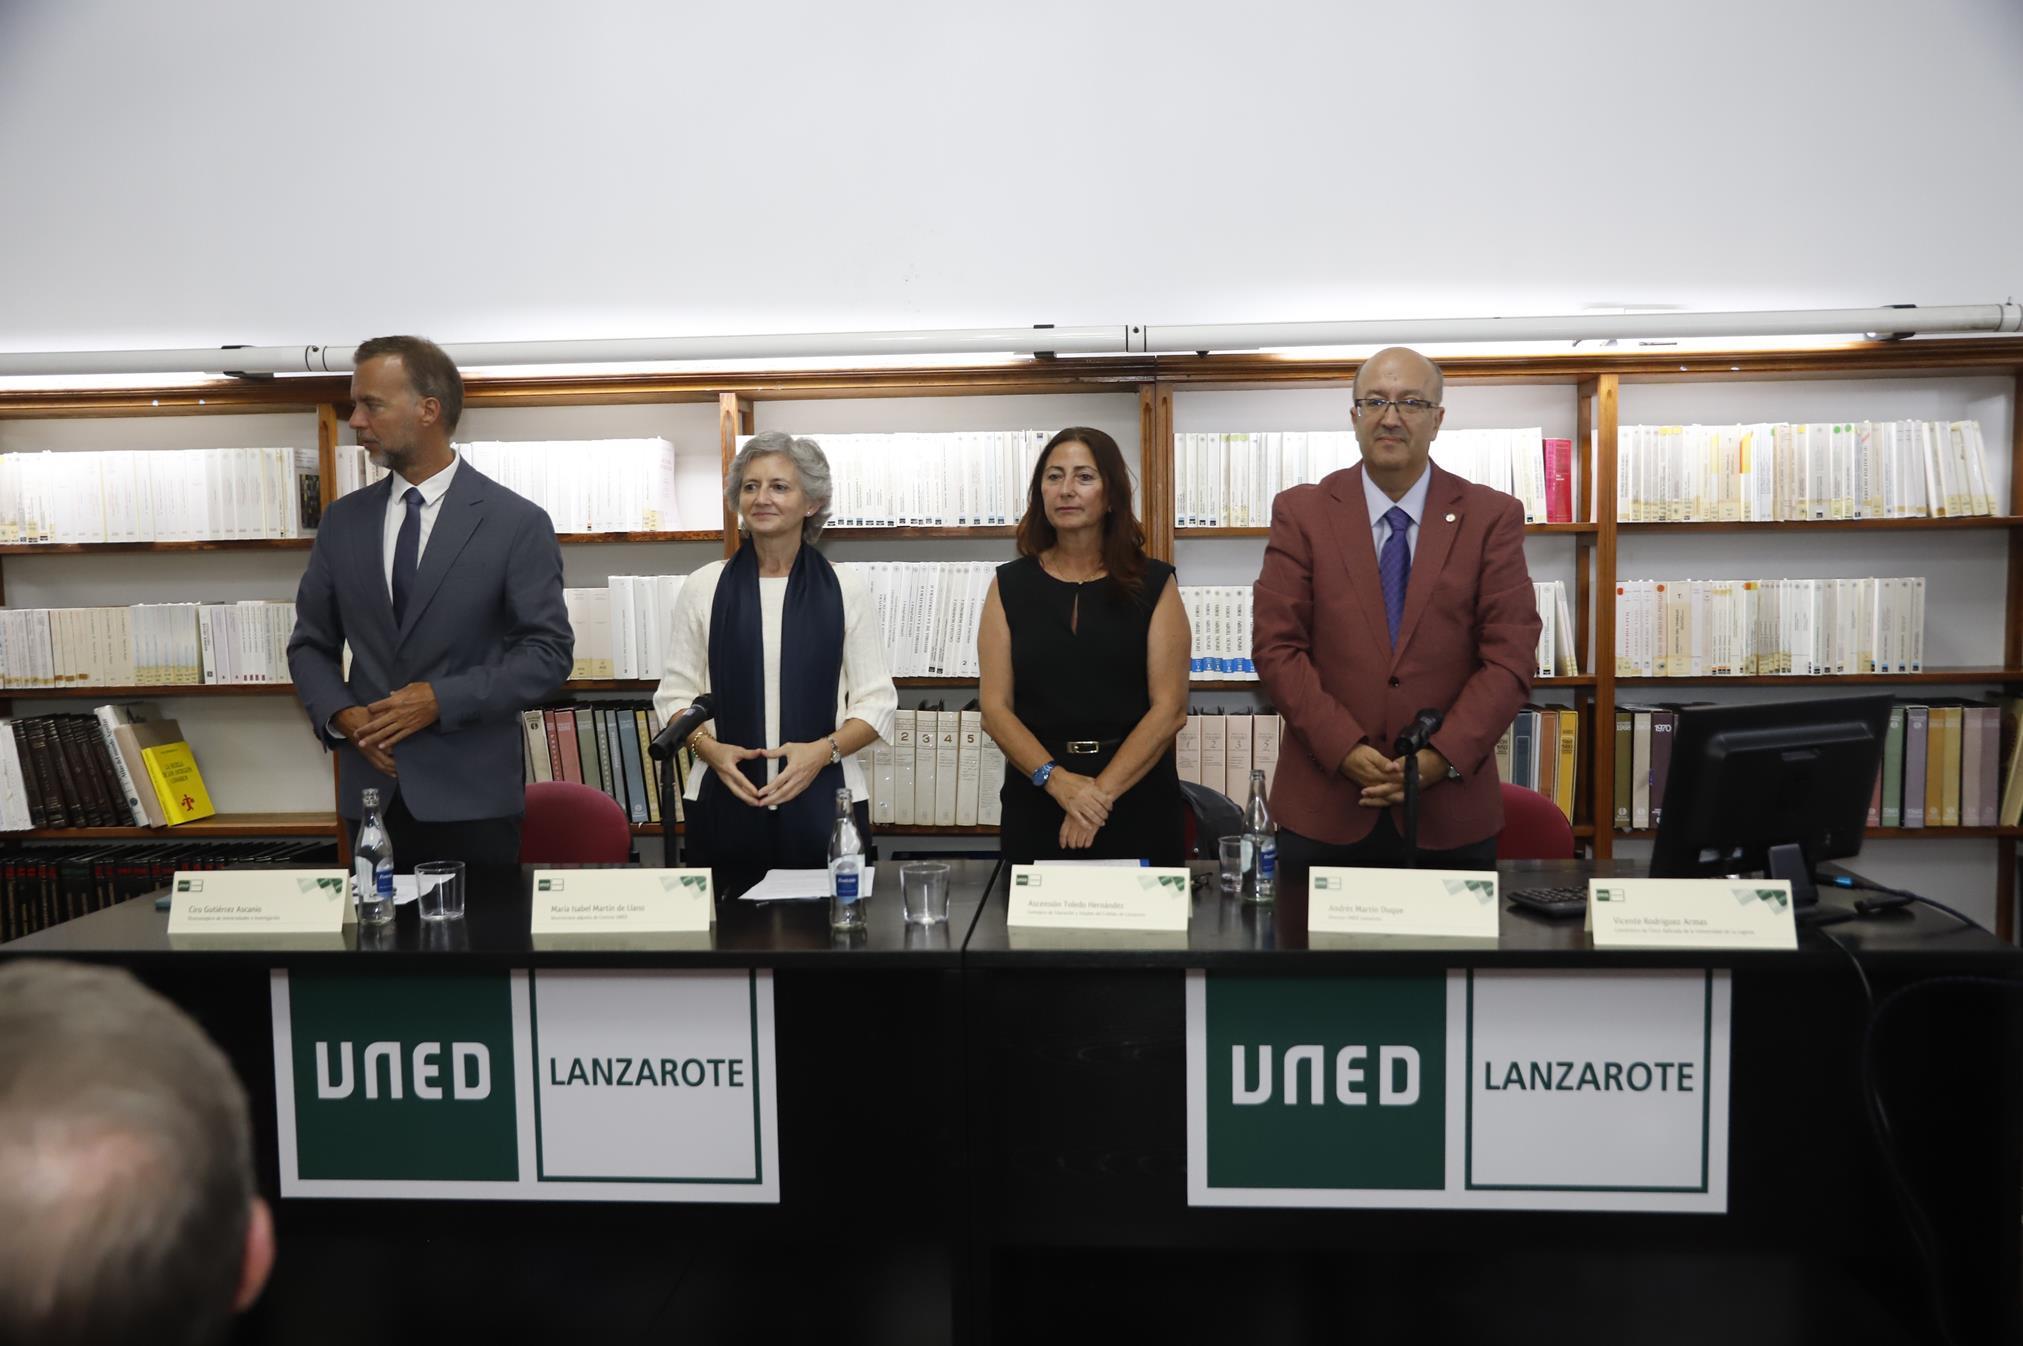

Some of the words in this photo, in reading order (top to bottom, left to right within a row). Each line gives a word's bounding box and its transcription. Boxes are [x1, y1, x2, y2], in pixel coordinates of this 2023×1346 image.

[1654, 724, 1672, 732] 1970
[901, 732, 909, 741] 2
[922, 734, 930, 743] 3
[944, 734, 952, 743] 4
[967, 734, 974, 743] 5
[1210, 740, 1216, 748] 2
[188, 904, 202, 913] Ciro
[204, 904, 234, 913] Gutiérrez
[551, 904, 570, 912] María
[571, 904, 591, 912] Isabel
[592, 904, 615, 912] Martín
[1064, 900, 1087, 908] Toledo
[1380, 905, 1404, 915] Duque
[1613, 917, 1642, 925] Vicente
[316, 1041, 492, 1100] UNED
[550, 1057, 744, 1088] LANZAROTE
[1231, 1044, 1420, 1106] UNED
[1484, 1061, 1694, 1092] LANZAROTE
